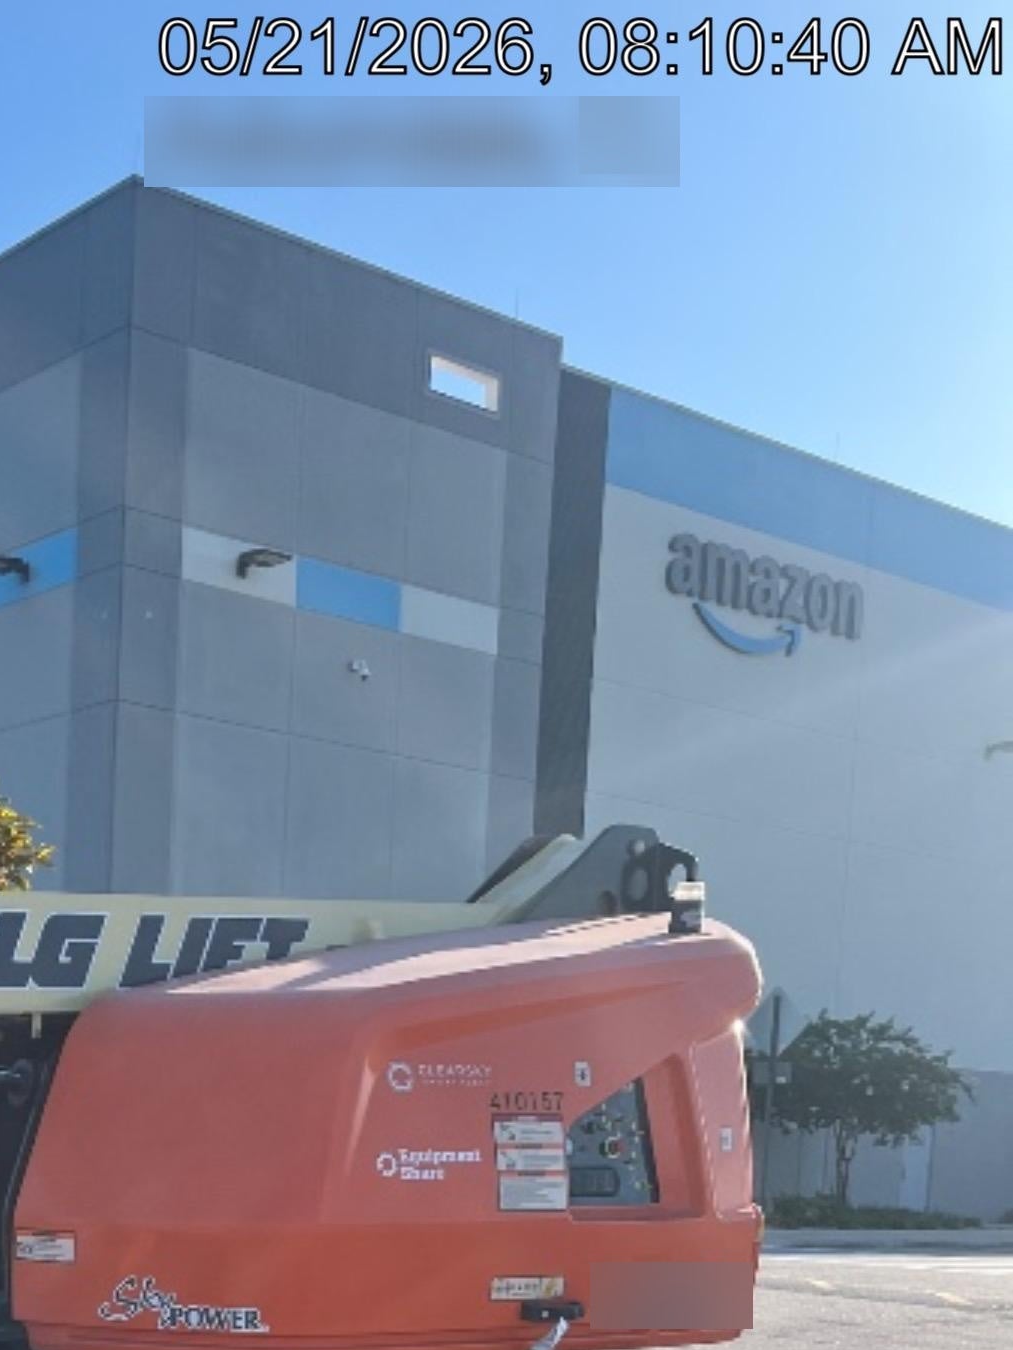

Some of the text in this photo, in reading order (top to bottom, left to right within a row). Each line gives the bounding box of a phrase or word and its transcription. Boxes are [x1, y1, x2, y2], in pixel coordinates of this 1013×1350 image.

[665, 533, 864, 640] amazon
[117, 914, 310, 989] LIFT
[489, 1092, 564, 1111] 410157
[398, 1148, 481, 1165] Equipment
[400, 1166, 444, 1180] Share
[169, 1305, 264, 1331] POWER
